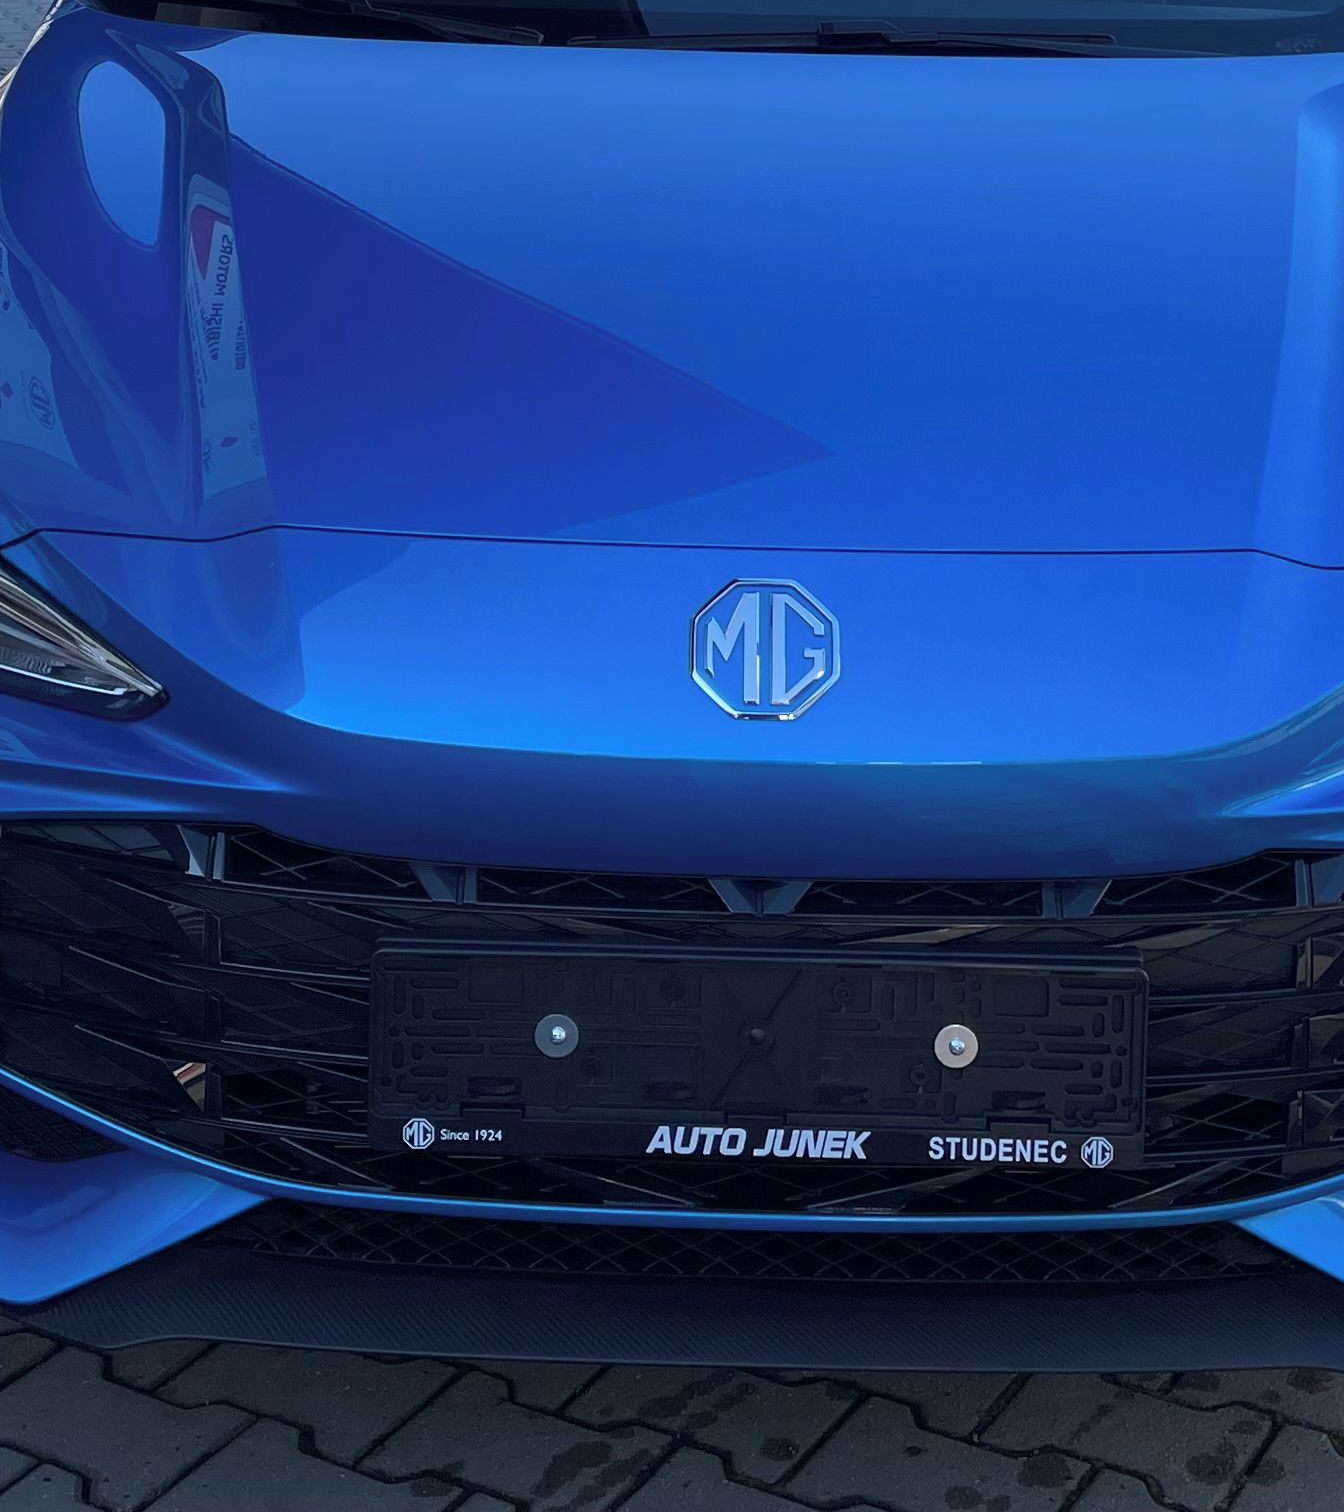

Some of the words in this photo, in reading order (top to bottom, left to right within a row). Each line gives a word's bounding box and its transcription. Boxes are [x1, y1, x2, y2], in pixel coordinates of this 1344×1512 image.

[702, 589, 828, 708] MG
[405, 1120, 433, 1148] MG
[440, 1128, 470, 1141] Since
[474, 1129, 503, 1142] 1924
[645, 1125, 748, 1156] AUTO
[753, 1128, 872, 1160] JUNEK
[928, 1135, 1068, 1164] STUDENEC
[1082, 1138, 1112, 1168] MG
